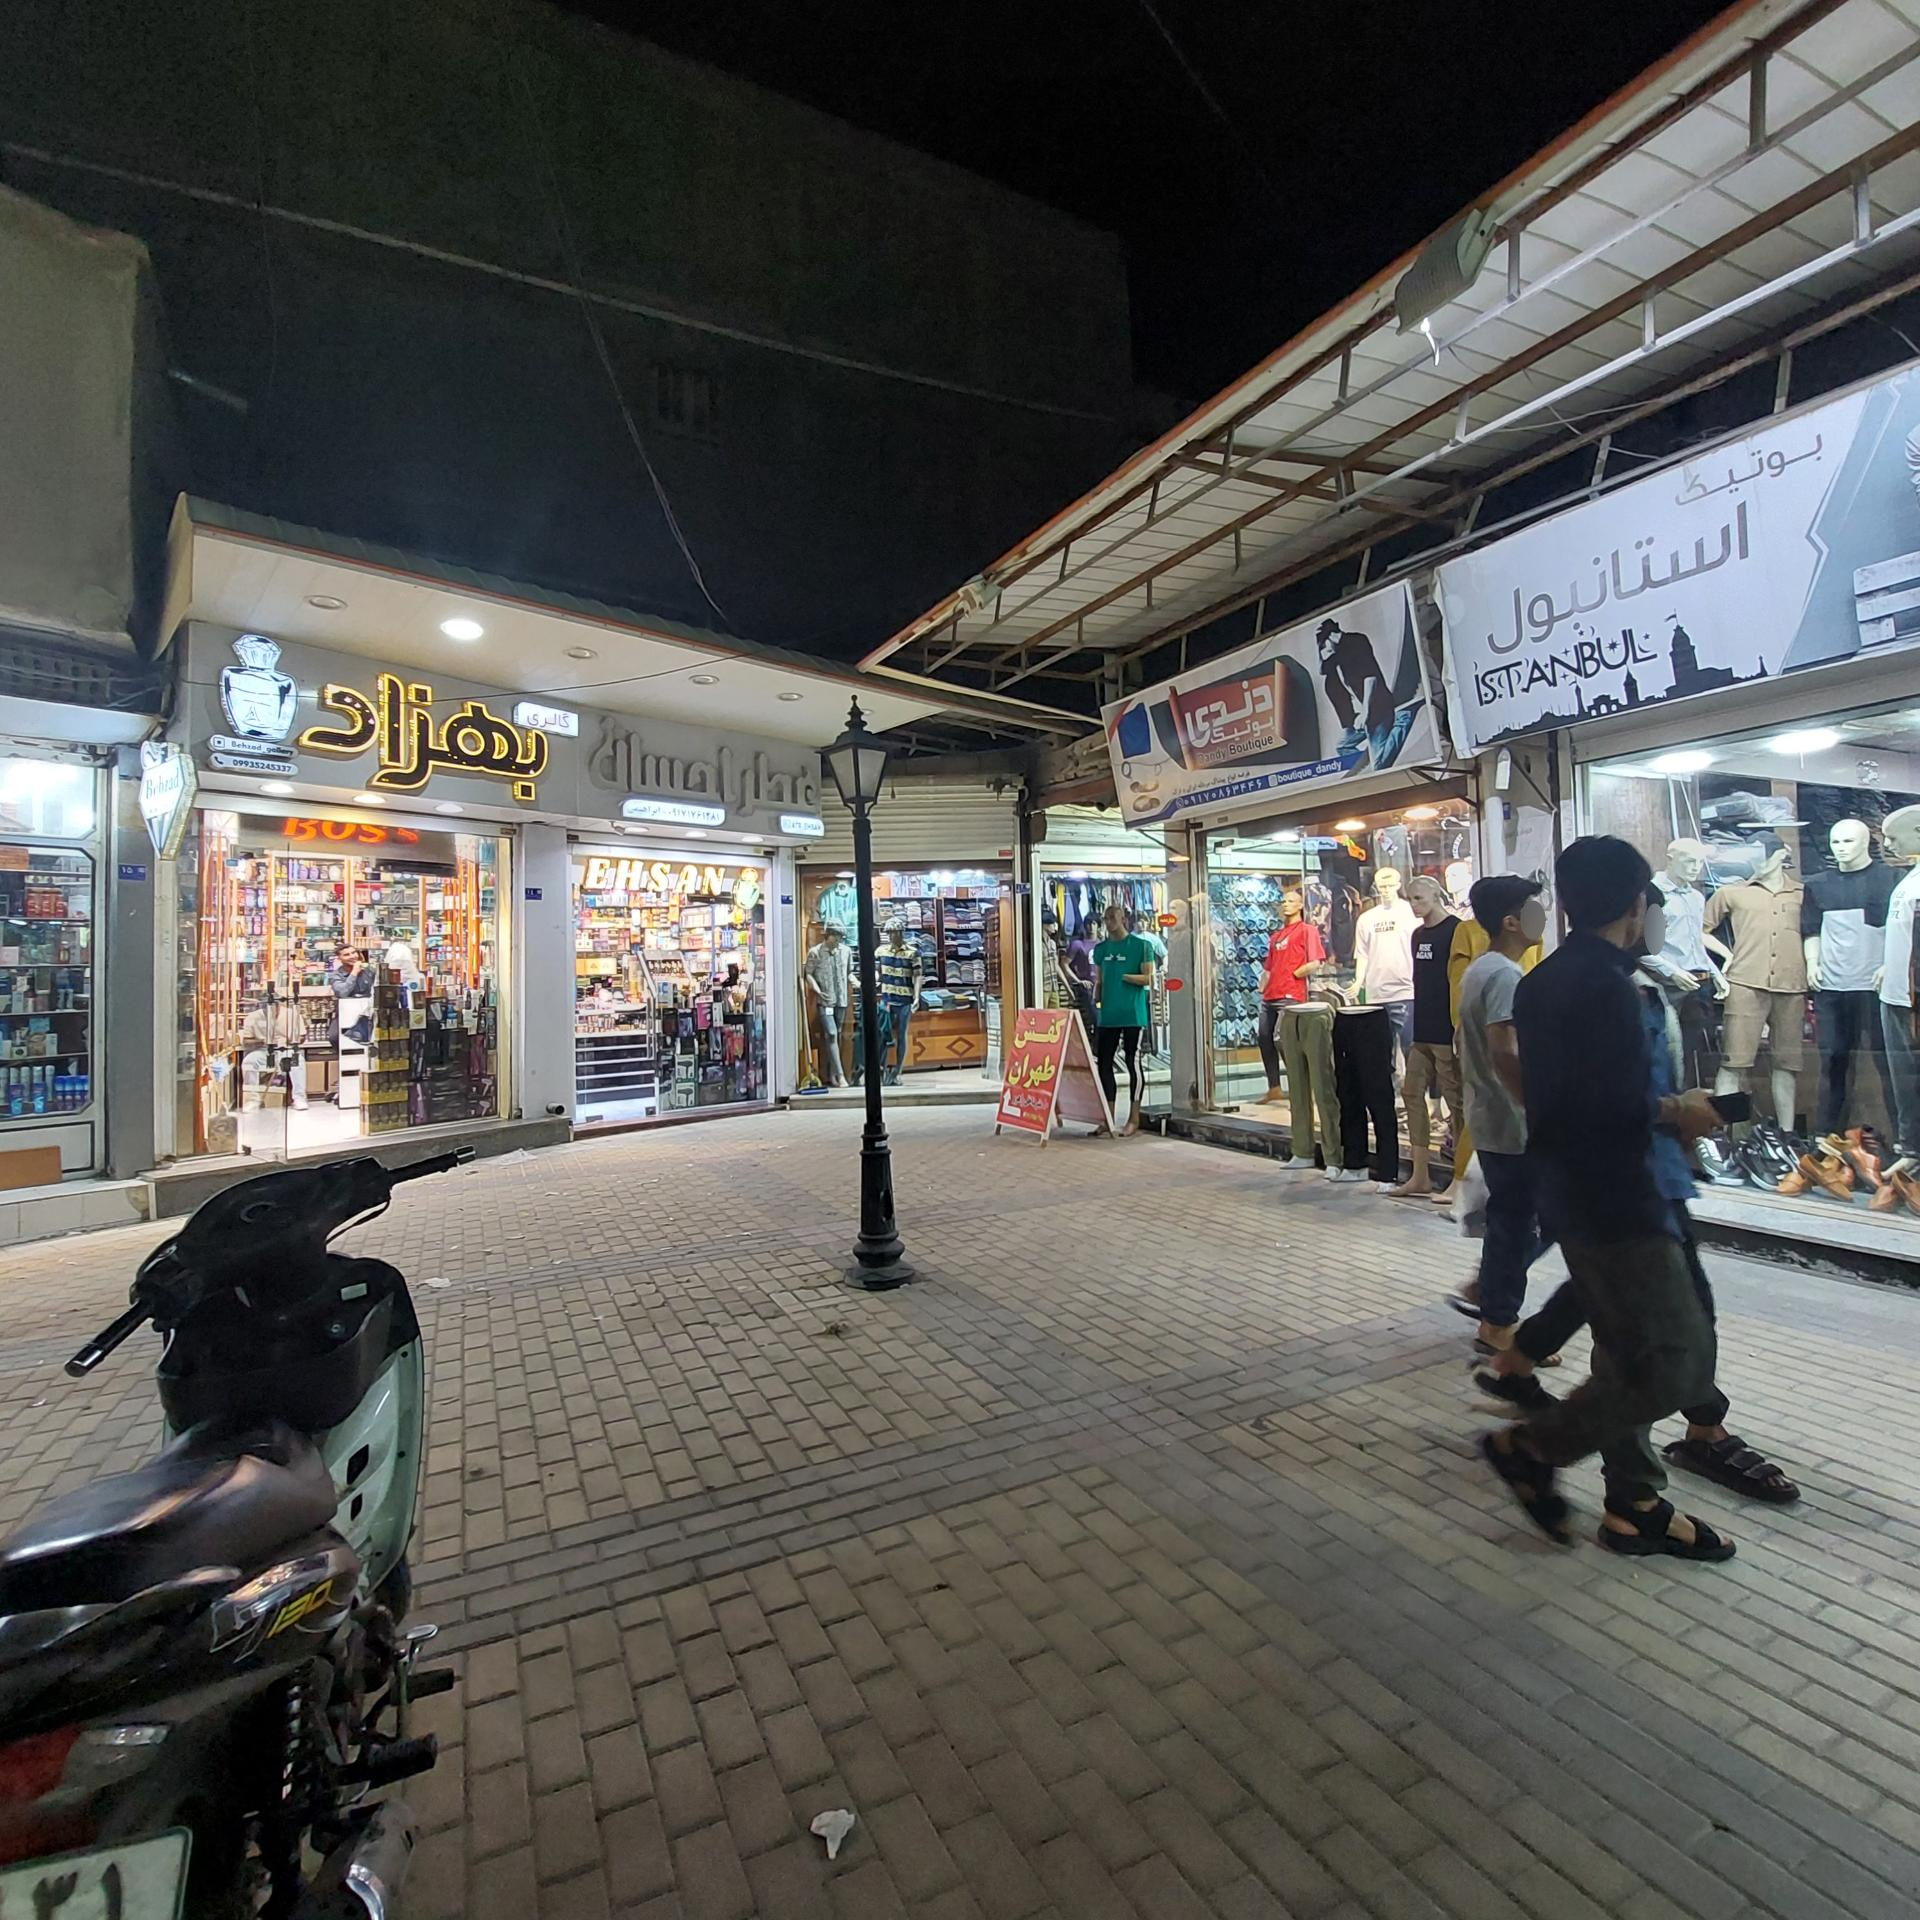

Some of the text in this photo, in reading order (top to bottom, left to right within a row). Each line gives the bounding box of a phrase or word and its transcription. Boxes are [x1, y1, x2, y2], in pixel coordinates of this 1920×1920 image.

[1675, 432, 1823, 507] بوتیک
[1487, 500, 1750, 655] استانبول
[526, 709, 571, 729] گالری
[1184, 680, 1274, 748] دندی
[1210, 716, 1275, 744] بوتیک
[299, 672, 549, 801] بهزاد
[1198, 735, 1274, 761] Dandy Boutique
[232, 758, 292, 773] 09935245337
[1277, 760, 1343, 784] boutique_dandy
[583, 856, 726, 896] EHSAN
[1014, 1016, 1067, 1049] کفش
[1007, 1053, 1056, 1089] طهران
